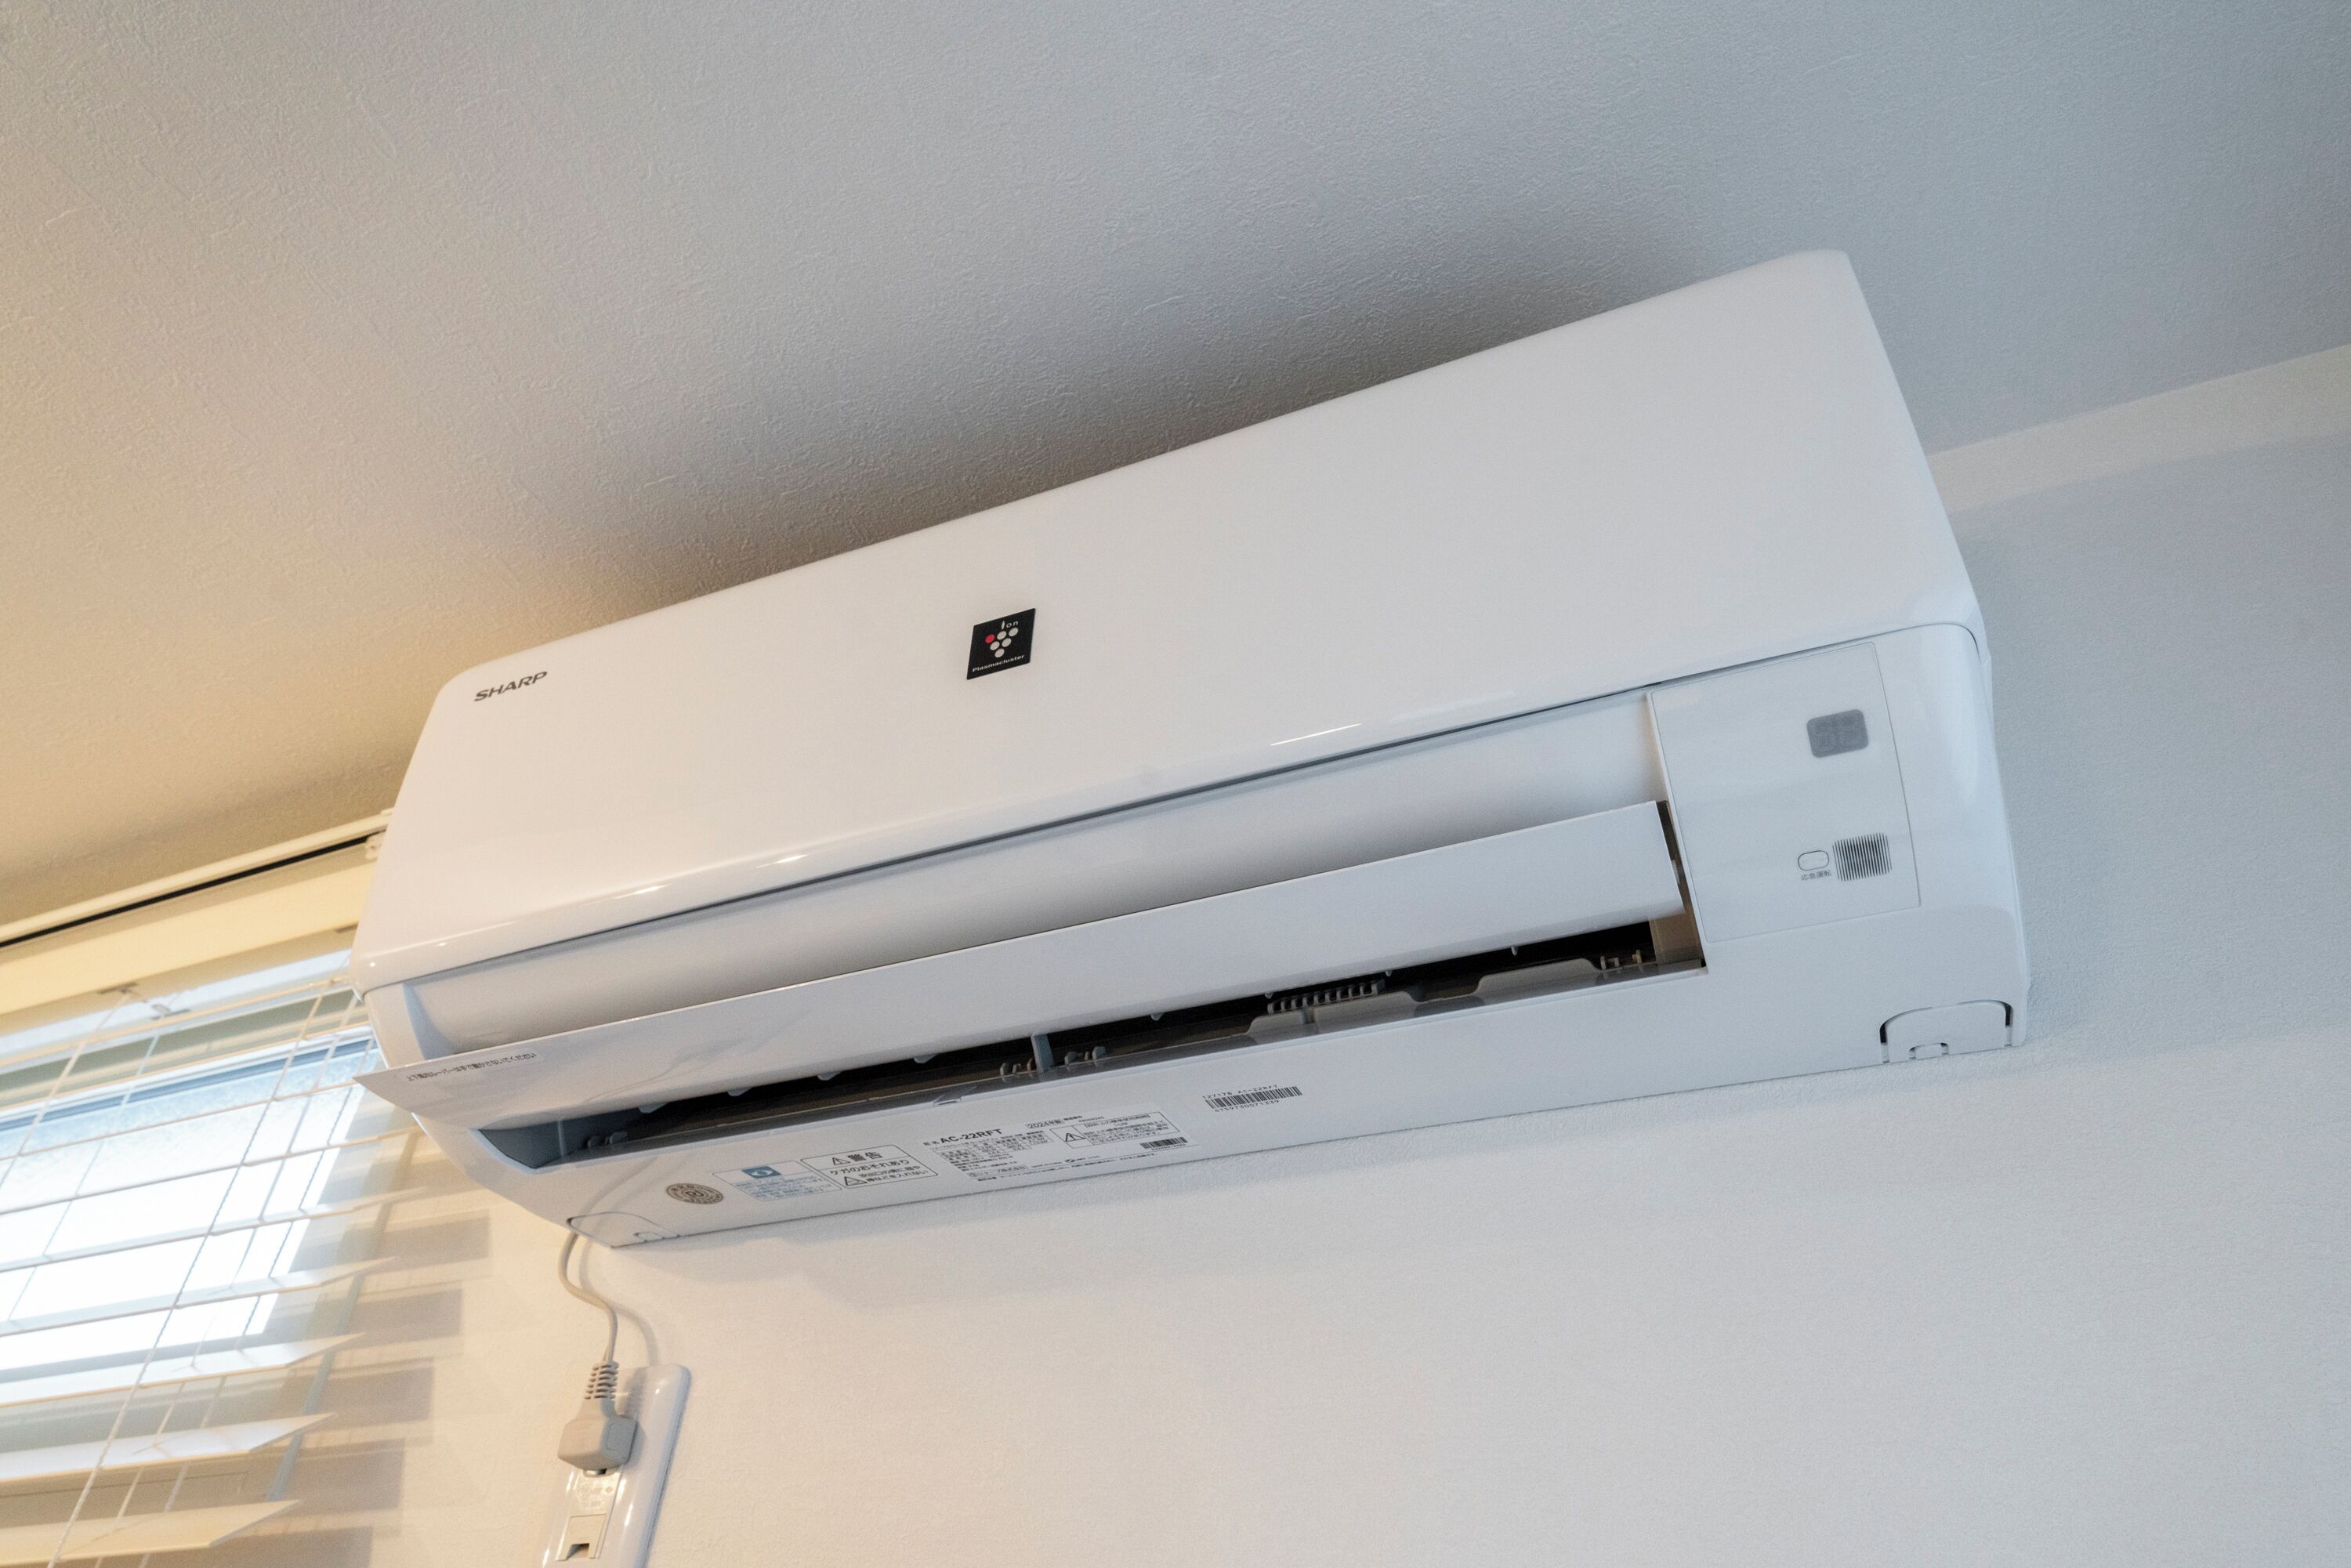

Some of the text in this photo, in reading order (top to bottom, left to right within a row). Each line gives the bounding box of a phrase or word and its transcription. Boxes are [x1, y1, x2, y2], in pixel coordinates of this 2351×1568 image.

[972, 654, 1025, 673] Plasmacluster
[474, 671, 548, 701] SHARP
[940, 1128, 1002, 1144] AC-22RFT
[847, 1151, 883, 1162] 警告
[830, 1159, 910, 1176] ケガのおそれあり
